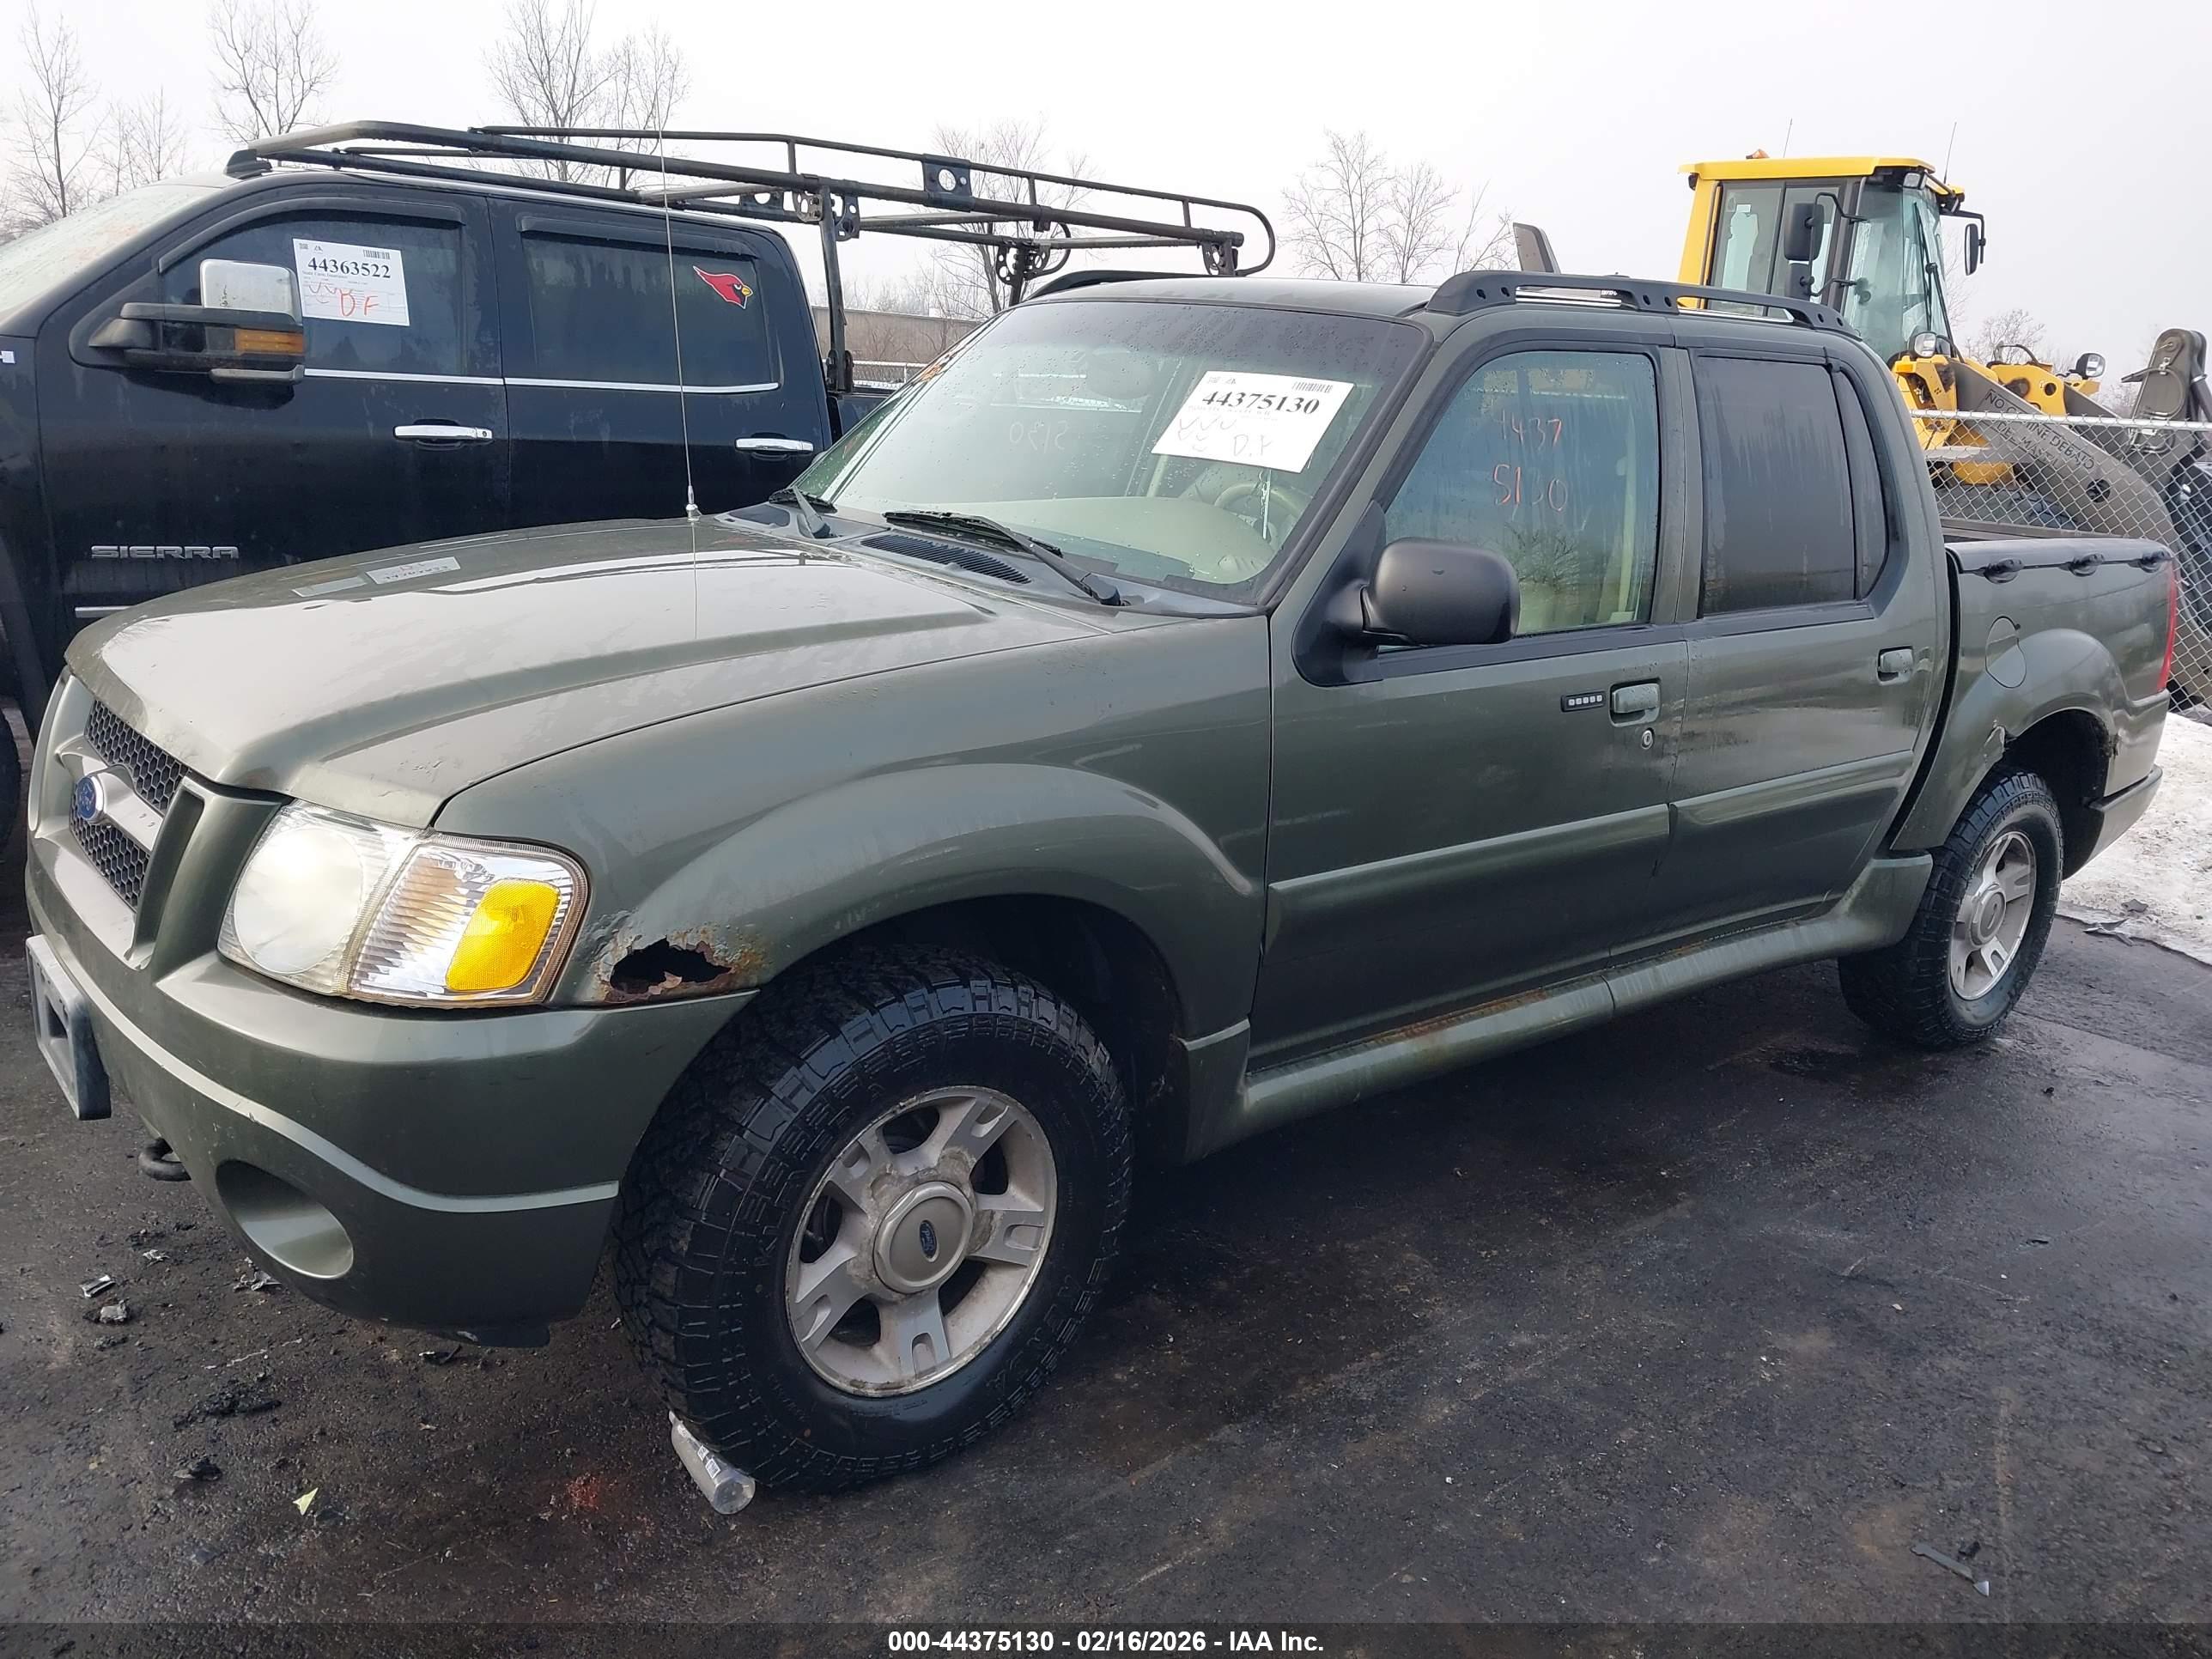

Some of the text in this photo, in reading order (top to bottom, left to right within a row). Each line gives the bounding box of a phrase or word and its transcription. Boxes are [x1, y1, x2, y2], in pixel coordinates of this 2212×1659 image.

[307, 257, 391, 279] 44363522
[1202, 391, 1320, 414] 44375130
[1984, 392, 2005, 409] NO
[91, 545, 239, 558] SIERRA
